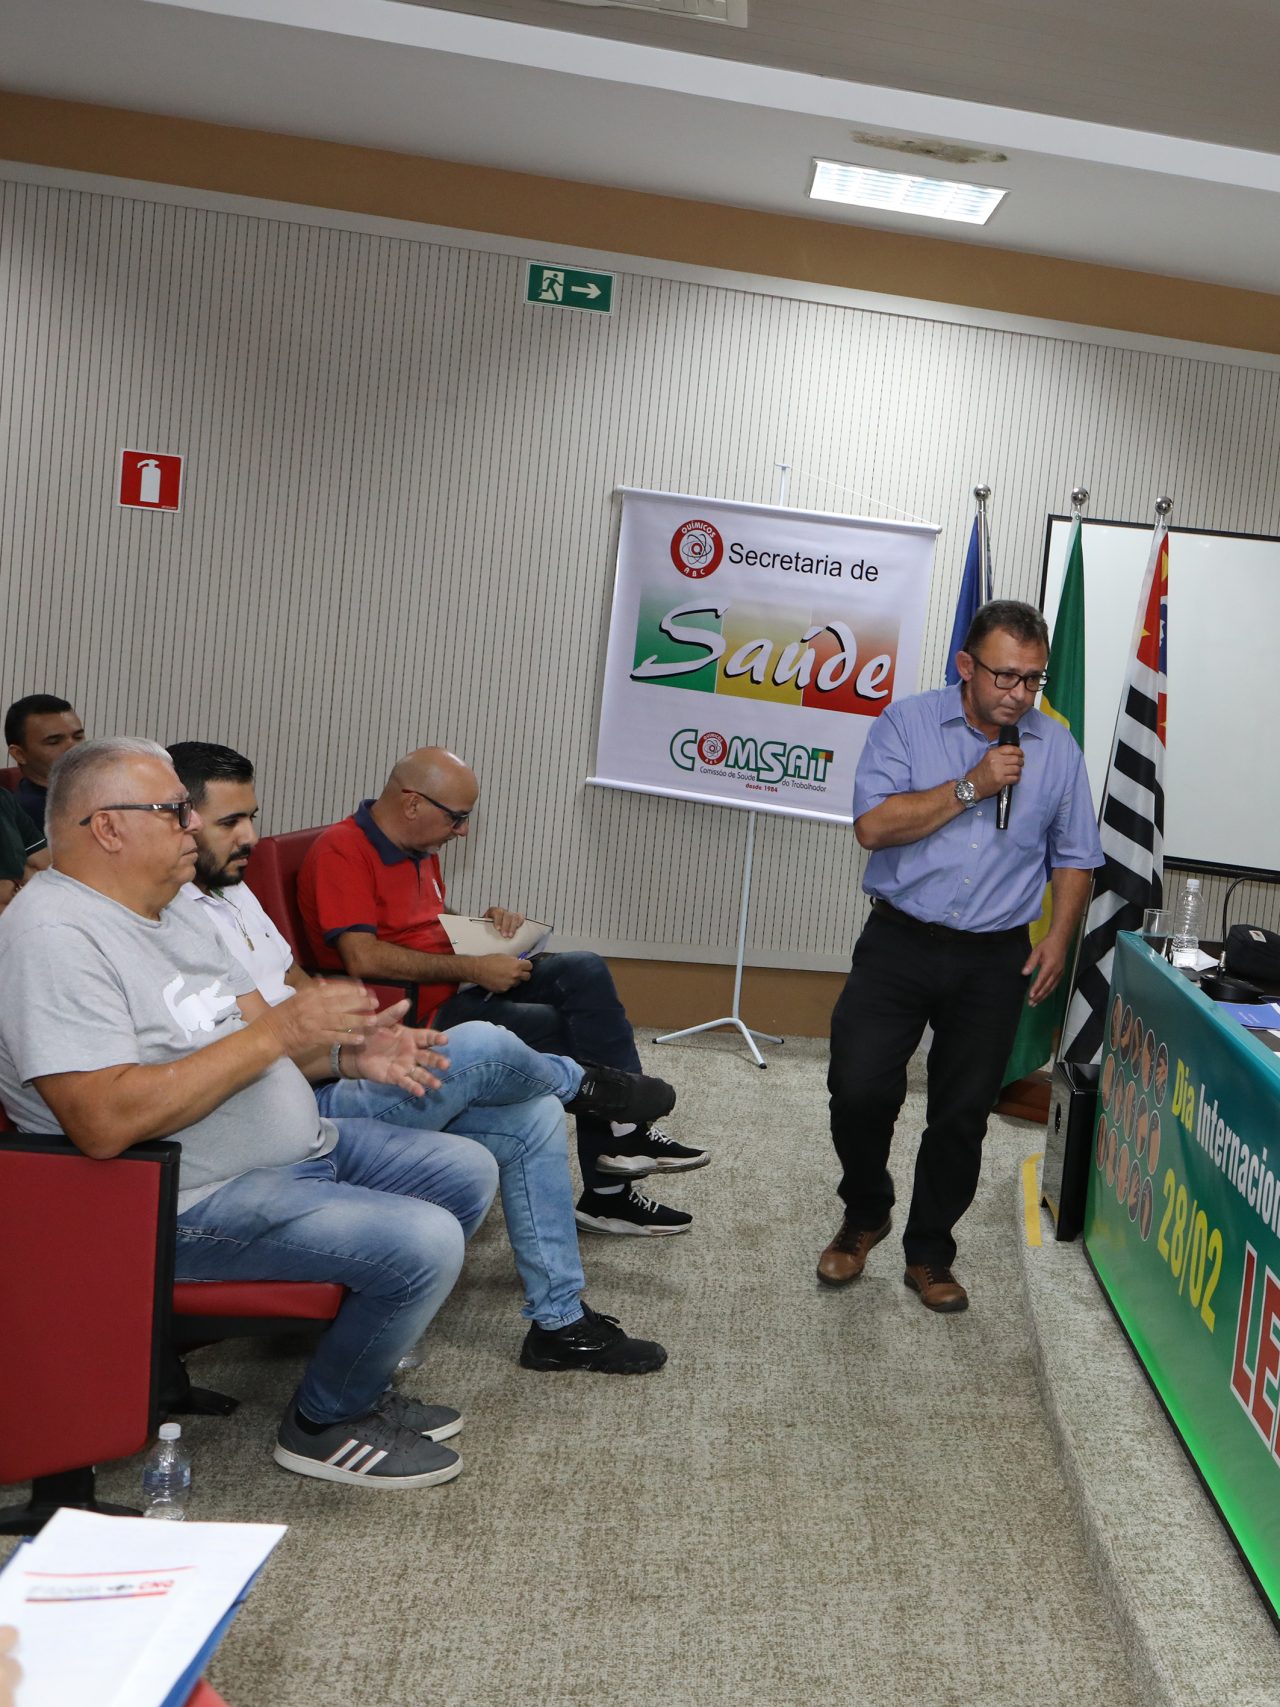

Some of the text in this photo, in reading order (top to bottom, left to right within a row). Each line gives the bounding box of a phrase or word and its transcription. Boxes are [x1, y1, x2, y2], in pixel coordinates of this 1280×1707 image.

[681, 521, 716, 538] QUÍMICOS
[728, 542, 879, 582] Secretaria de
[629, 602, 892, 700] Saúde
[670, 728, 834, 784] COMSAT
[728, 770, 736, 779] de
[745, 782, 778, 793] desde 1984
[1171, 1058, 1195, 1132] Dia
[1157, 1168, 1223, 1332] 28/02
